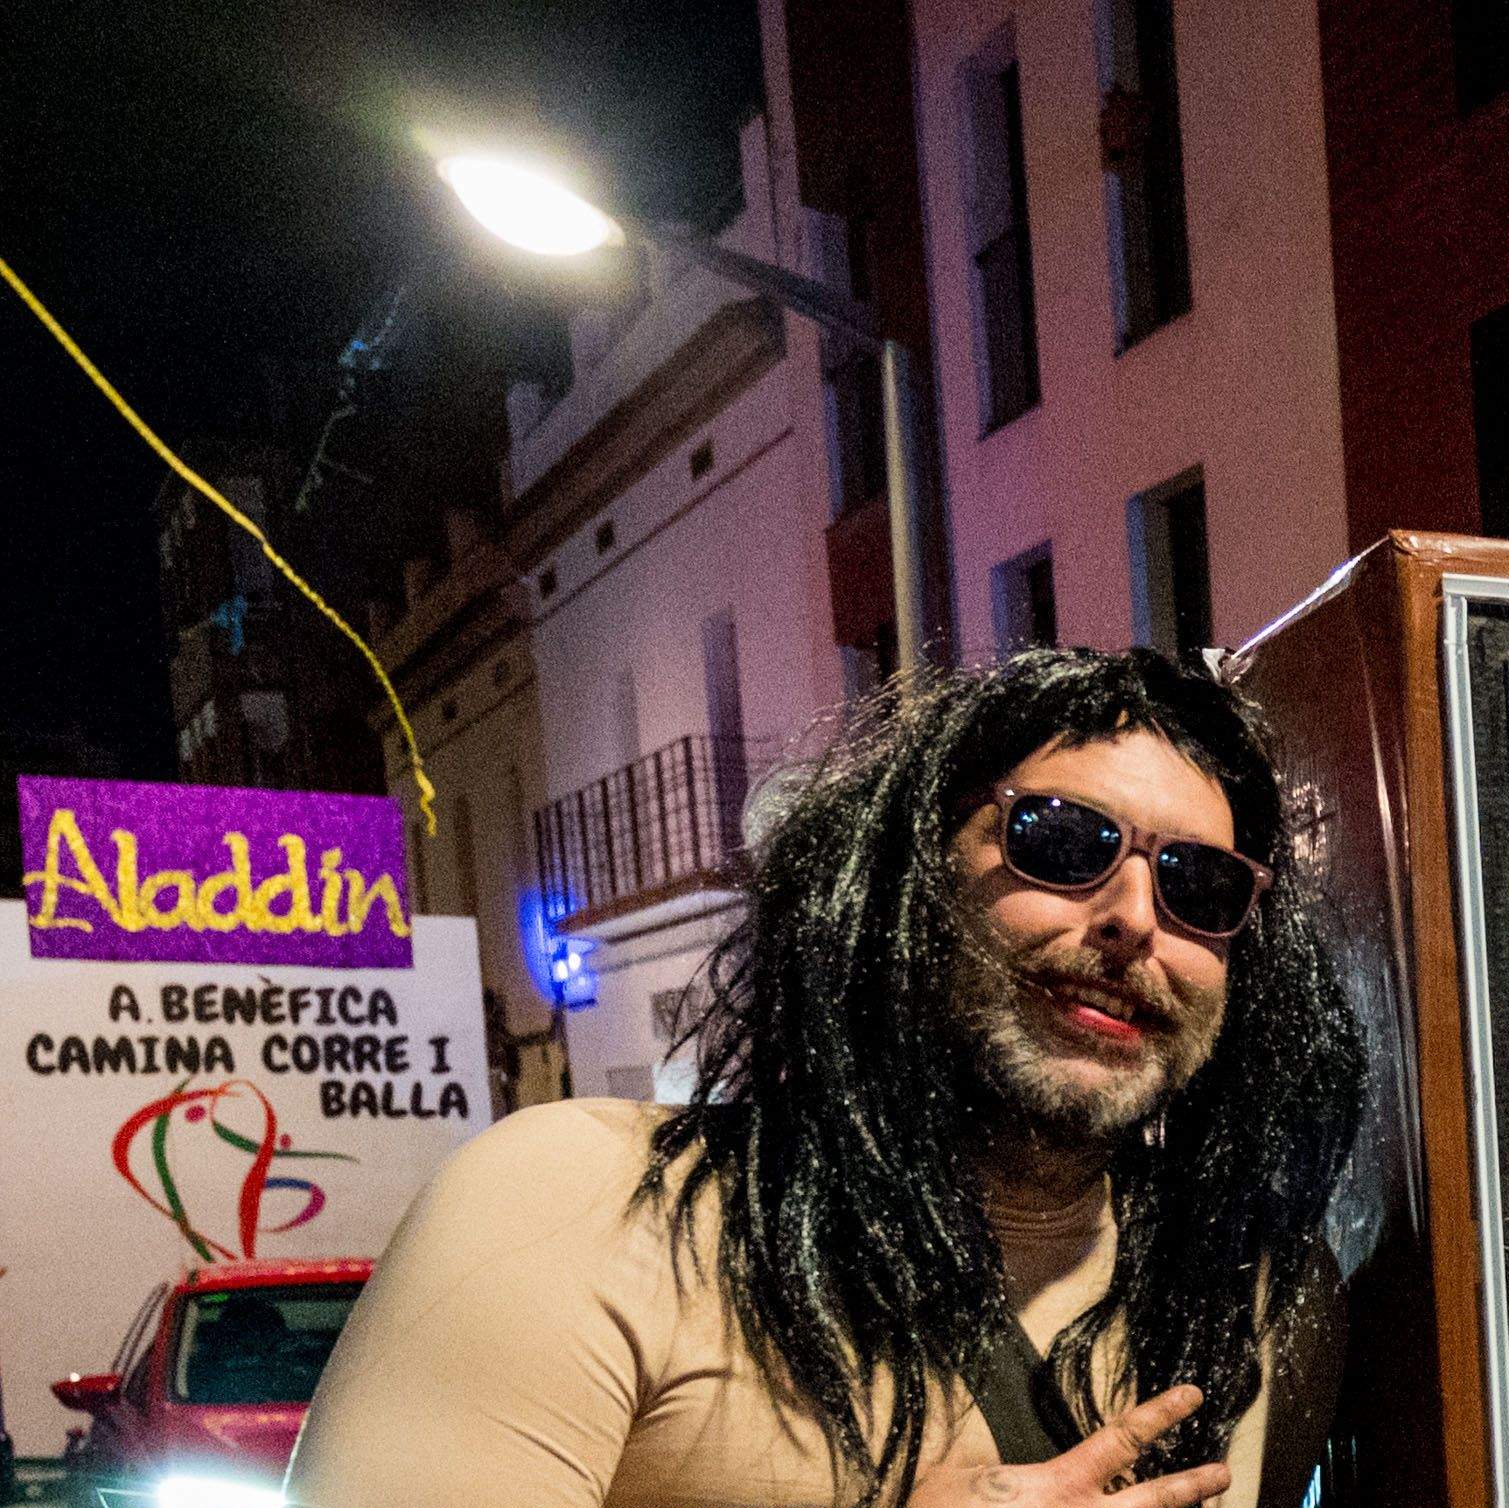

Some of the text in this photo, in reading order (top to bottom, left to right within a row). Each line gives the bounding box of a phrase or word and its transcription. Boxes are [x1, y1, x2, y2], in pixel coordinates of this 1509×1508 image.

[22, 808, 412, 937] Aladdin
[26, 1033, 451, 1075] CAMINA CORRE I
[319, 1080, 469, 1119] BALLA
